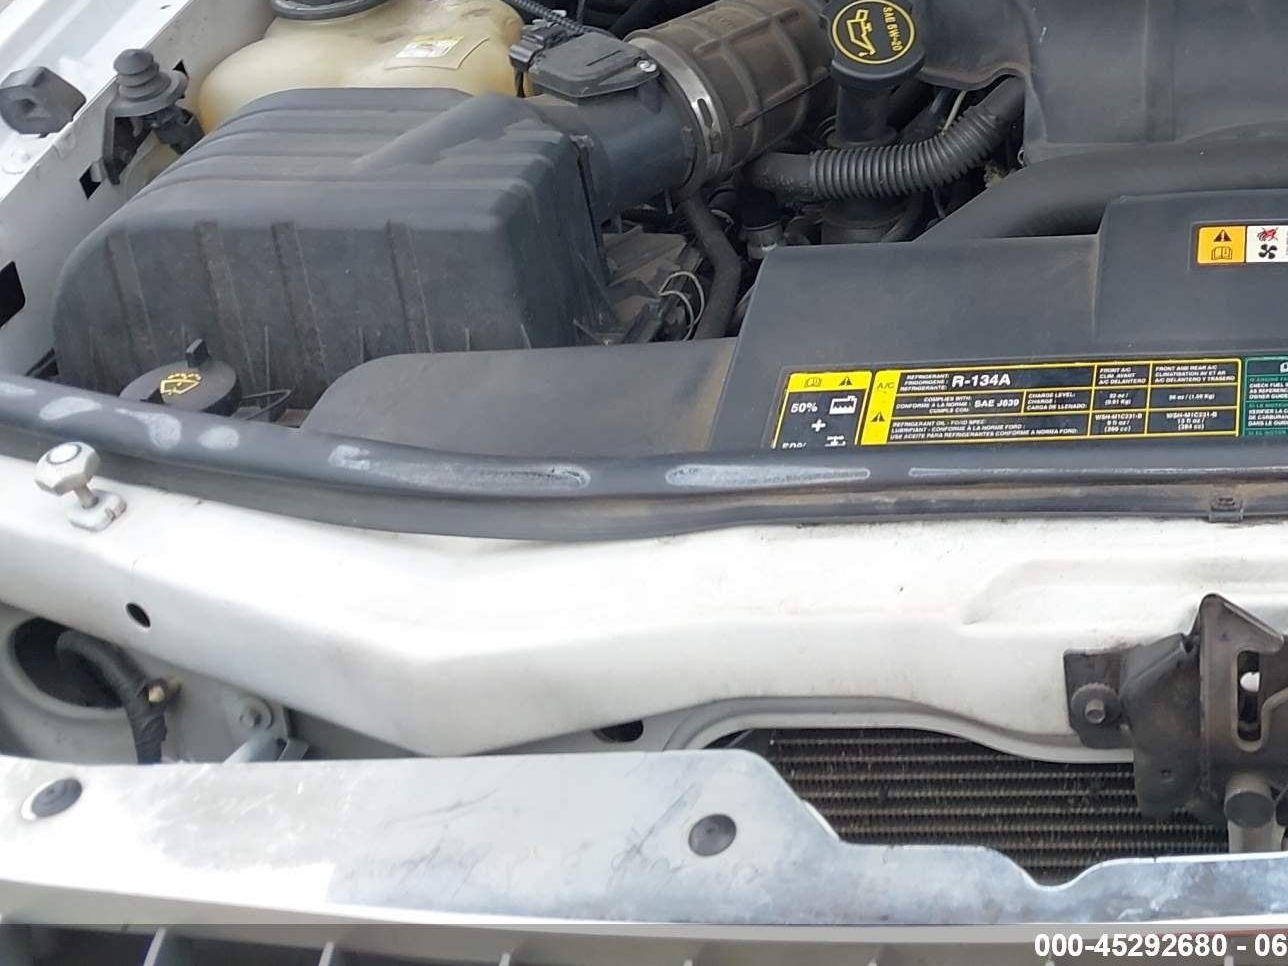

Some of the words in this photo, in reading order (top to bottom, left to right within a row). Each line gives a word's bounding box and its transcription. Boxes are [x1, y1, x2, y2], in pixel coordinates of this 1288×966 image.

[883, 7, 896, 23] SAE
[951, 373, 1012, 389] R-134A
[790, 402, 819, 414] 50%
[974, 399, 995, 409] SAE
